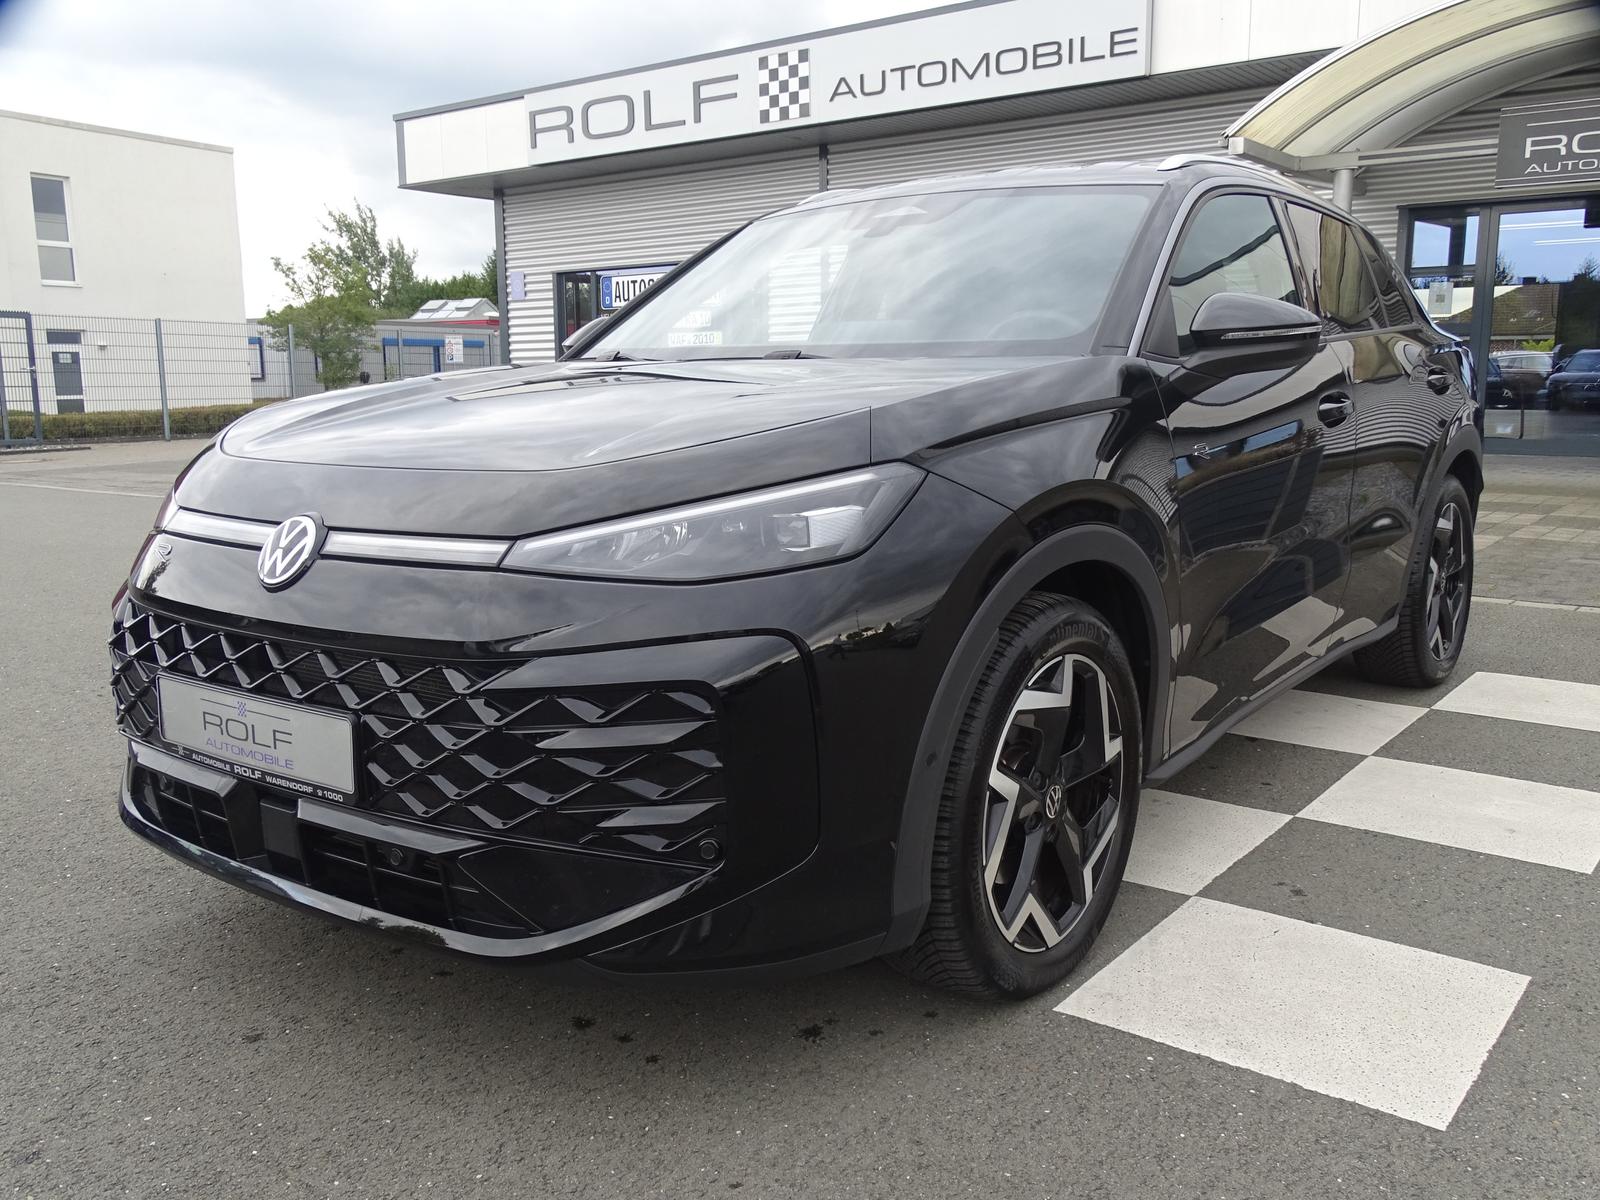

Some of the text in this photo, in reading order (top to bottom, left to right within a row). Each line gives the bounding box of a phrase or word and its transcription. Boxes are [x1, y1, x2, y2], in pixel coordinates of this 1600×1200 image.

[528, 27, 1139, 149] ROLF AUTOMOBILE
[1524, 158, 1600, 174] AUTO
[202, 711, 293, 750] ROLF
[206, 737, 294, 769] AUTOMOBILE
[192, 753, 344, 802] AUTOMOBILE ROLF WARENDORF 1000
